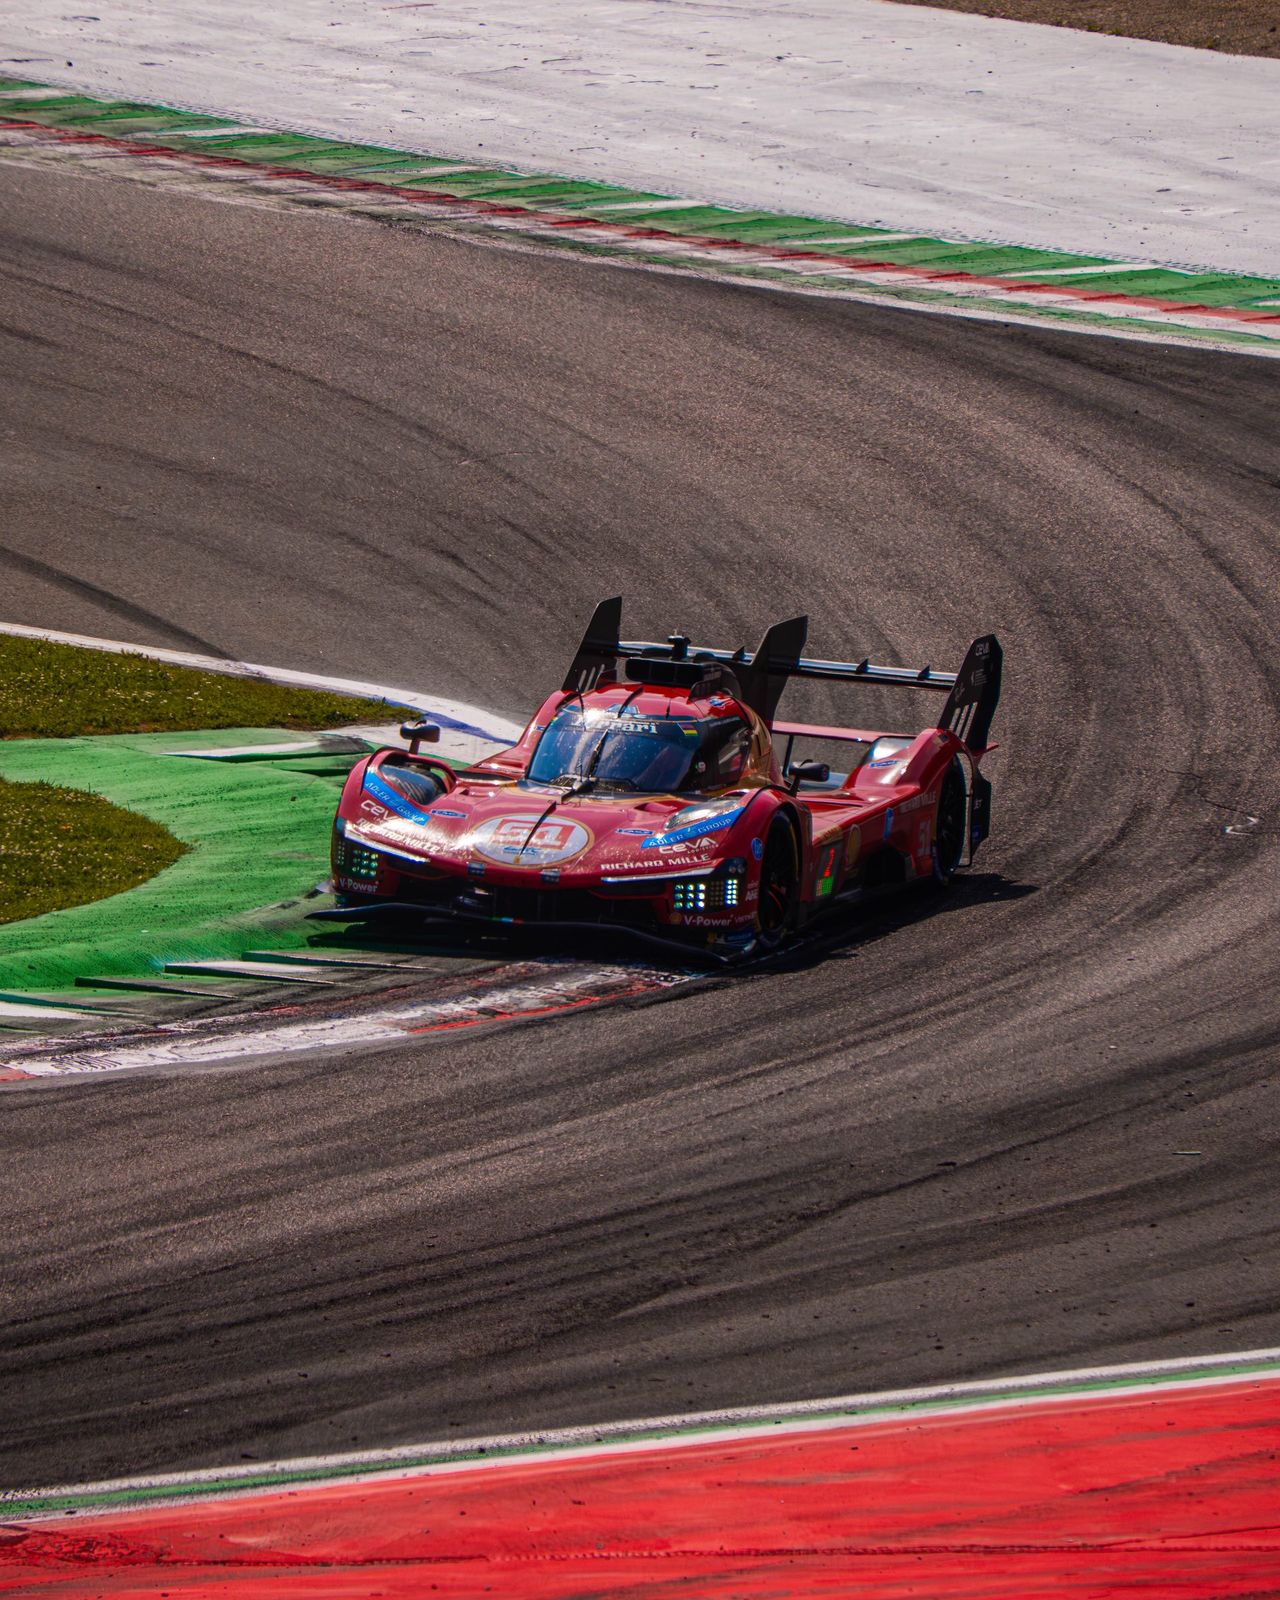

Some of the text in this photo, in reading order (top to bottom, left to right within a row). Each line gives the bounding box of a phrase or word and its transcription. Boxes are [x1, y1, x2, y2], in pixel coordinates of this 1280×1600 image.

[491, 818, 576, 850] 51
[648, 818, 731, 846] ADLER GROUP
[600, 853, 711, 871] RICHARD MILLE
[339, 878, 378, 892] V-Power
[684, 915, 732, 927] V-Power
